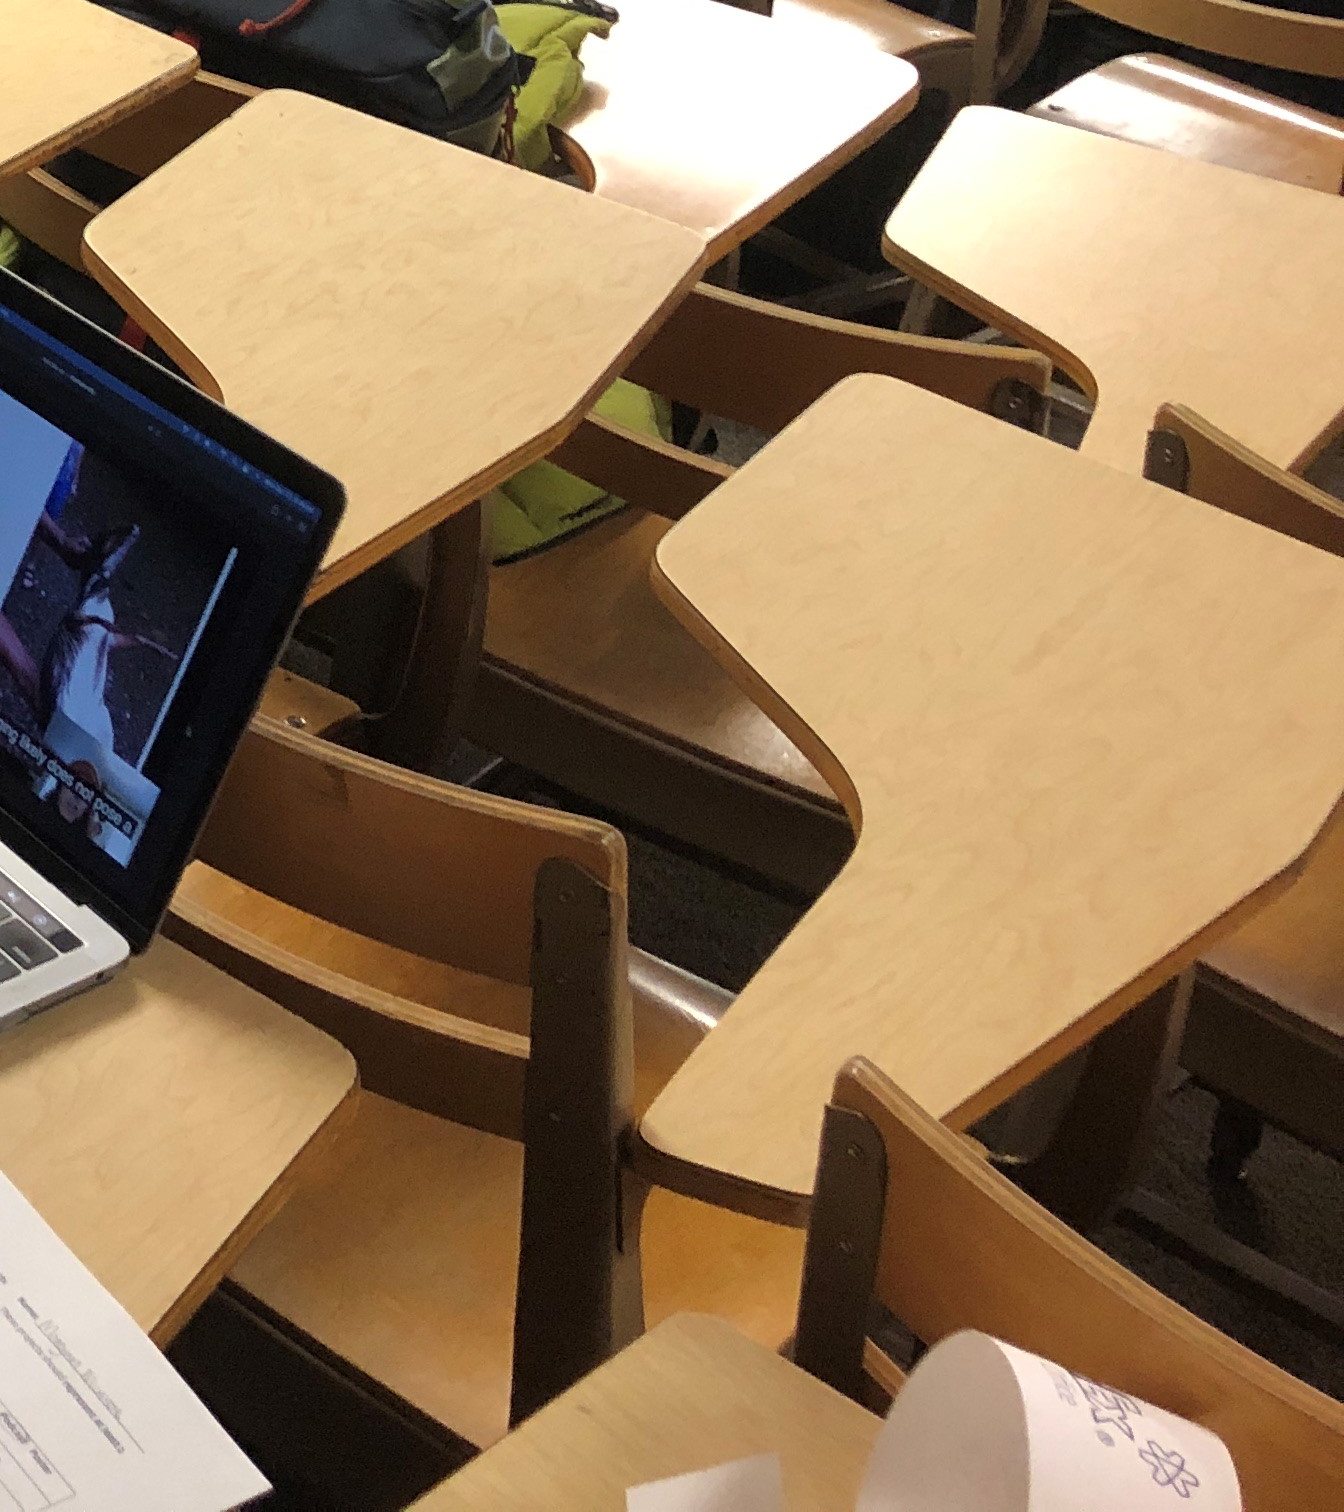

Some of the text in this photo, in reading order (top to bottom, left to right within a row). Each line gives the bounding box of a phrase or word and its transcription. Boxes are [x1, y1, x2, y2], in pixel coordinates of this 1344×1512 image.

[16, 733, 48, 768] likely
[45, 756, 76, 789] does
[72, 779, 95, 804] not
[91, 796, 123, 830] pose
[121, 819, 133, 835] a
